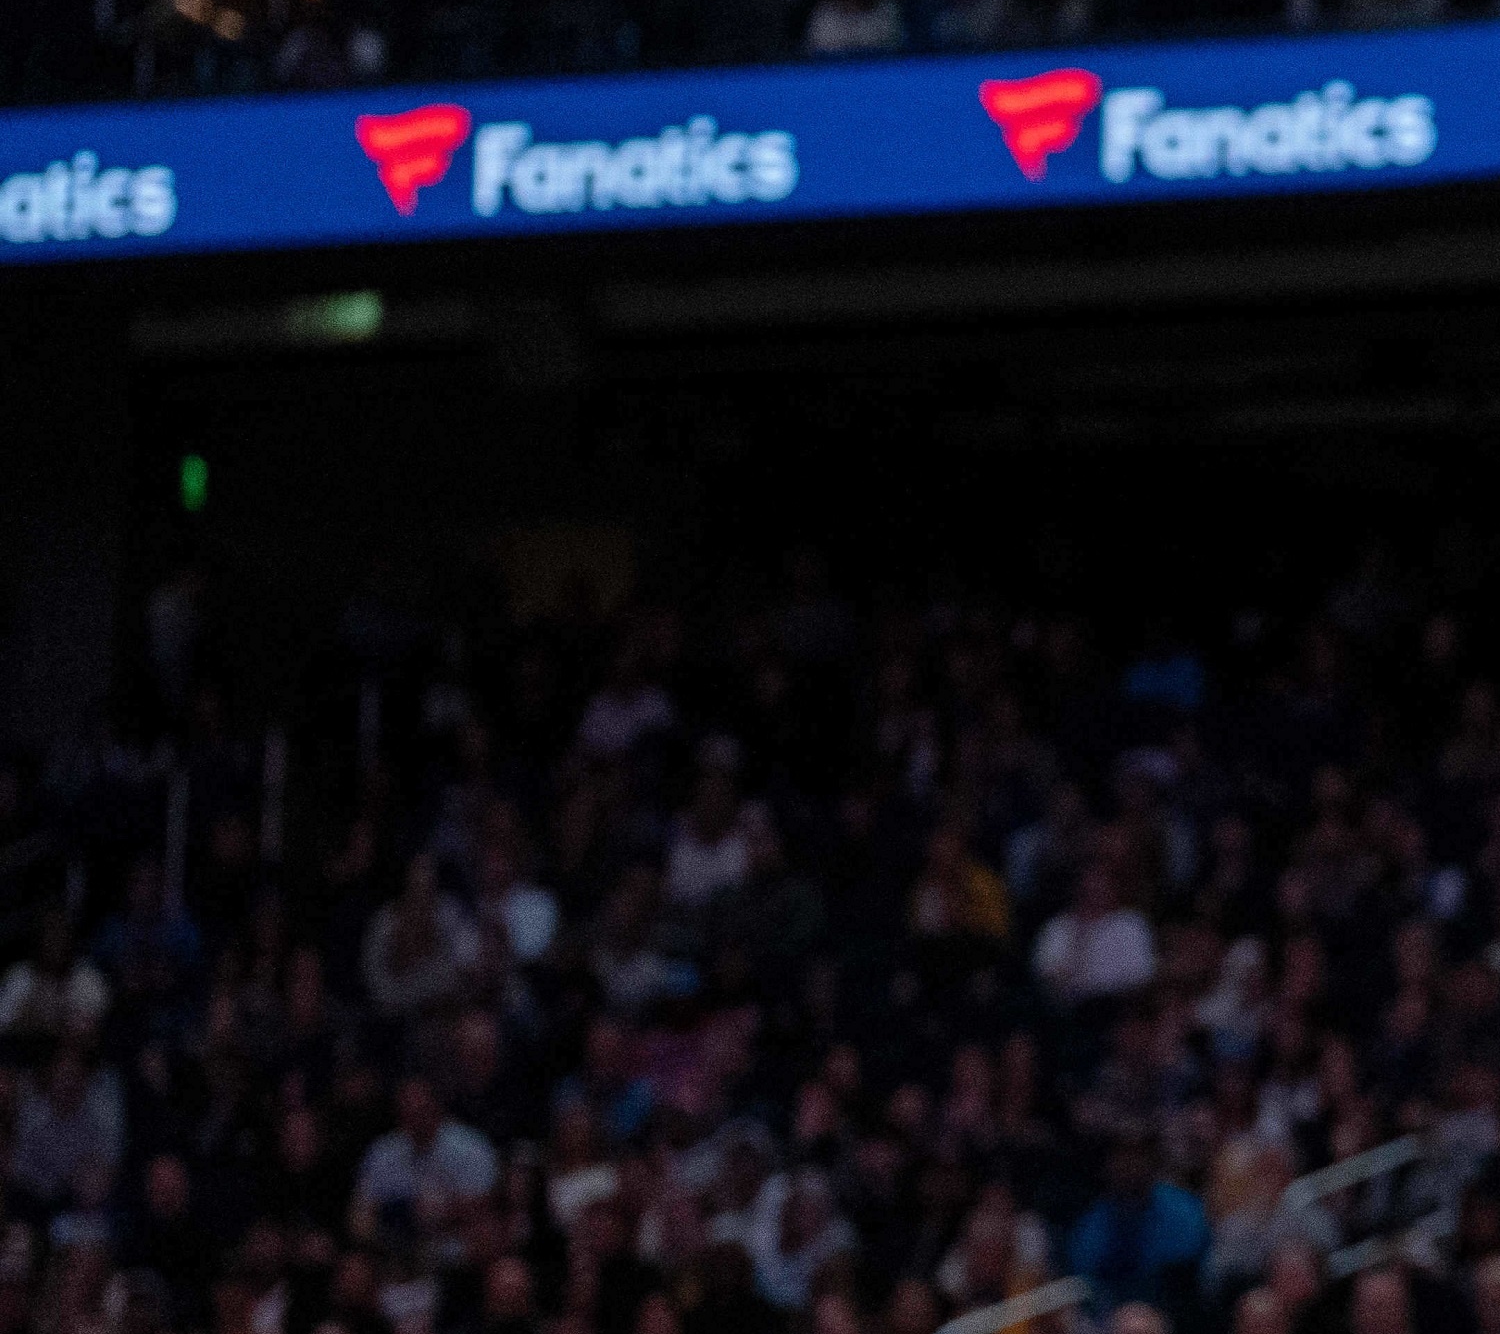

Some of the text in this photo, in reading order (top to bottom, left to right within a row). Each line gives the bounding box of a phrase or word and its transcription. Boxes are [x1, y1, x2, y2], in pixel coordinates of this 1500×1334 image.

[473, 117, 796, 215] Fanatics
[1102, 82, 1434, 180] Fanatics
[0, 151, 176, 241] atics
